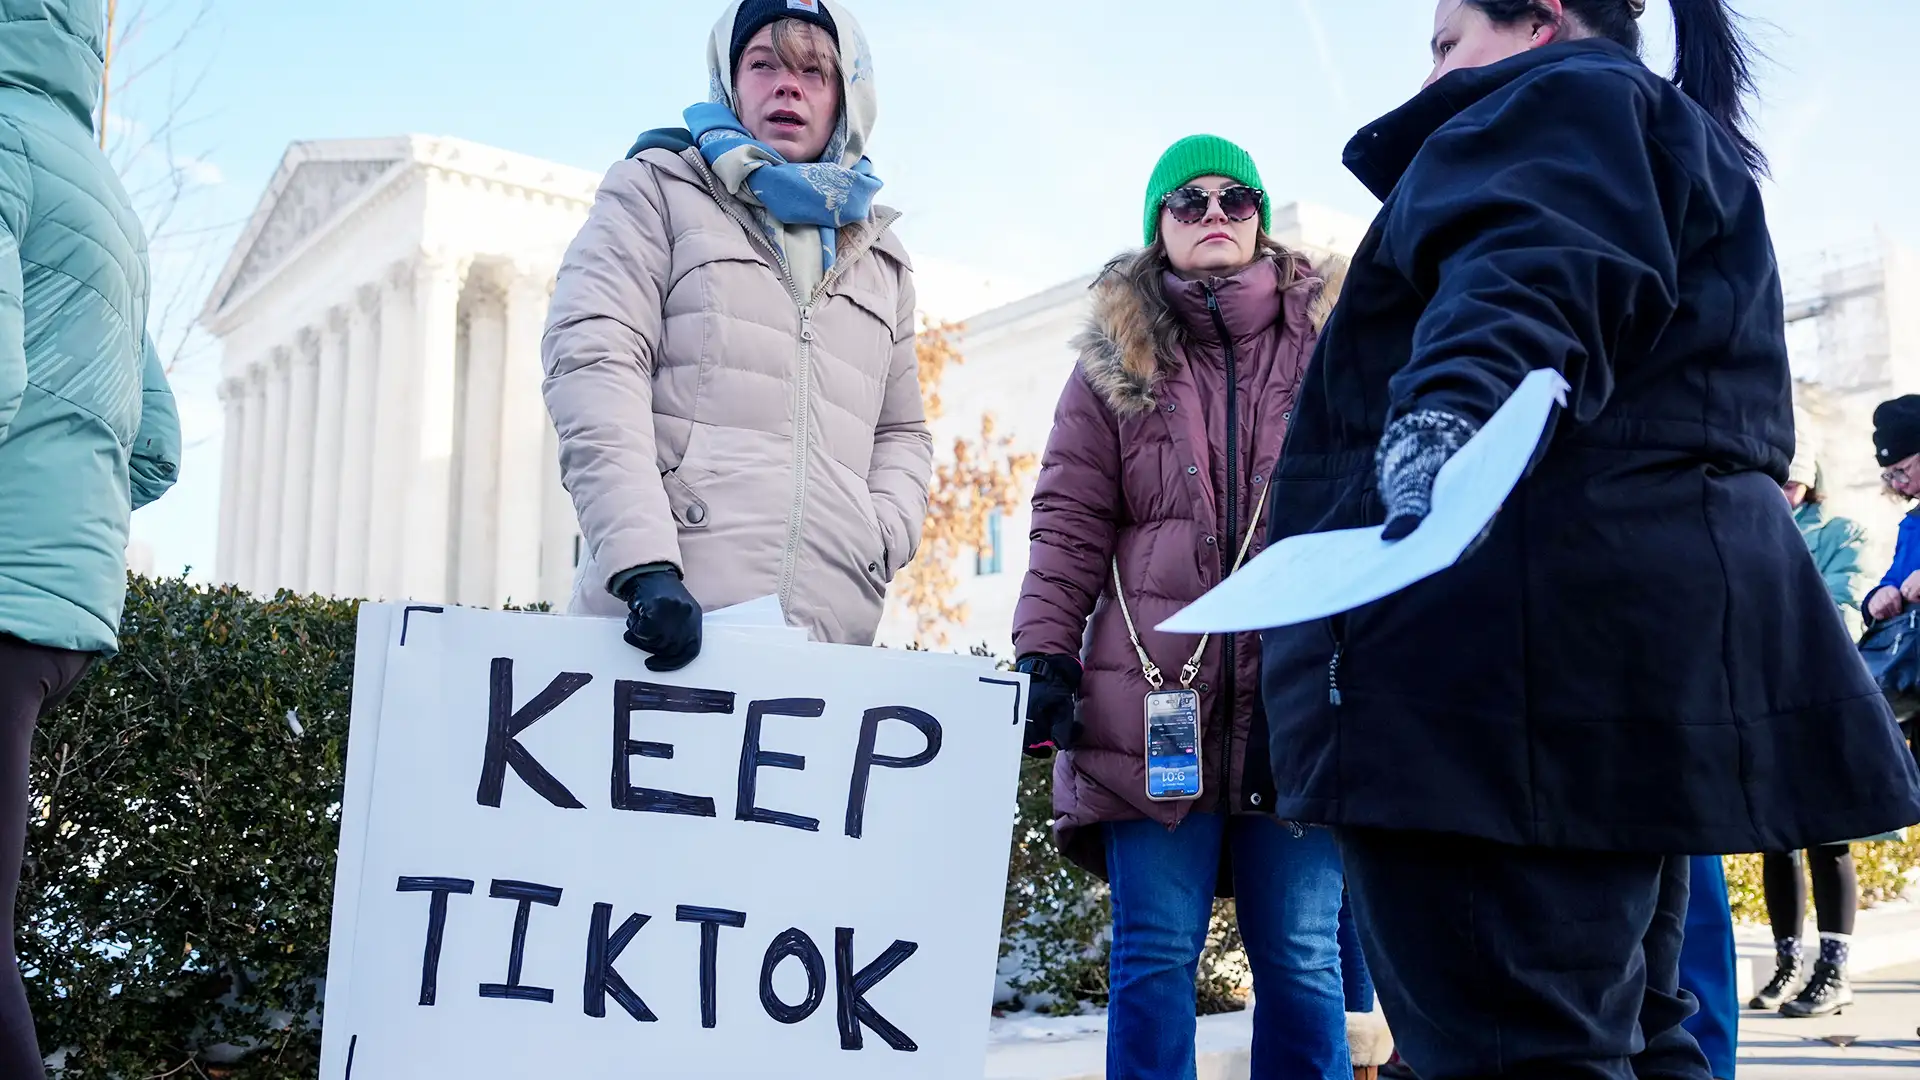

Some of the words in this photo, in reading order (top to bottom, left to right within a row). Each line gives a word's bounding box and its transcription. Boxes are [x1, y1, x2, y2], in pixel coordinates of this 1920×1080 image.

[476, 657, 943, 839] KEEP
[1162, 771, 1185, 782] 9:01
[396, 875, 919, 1052] TIKTOK
